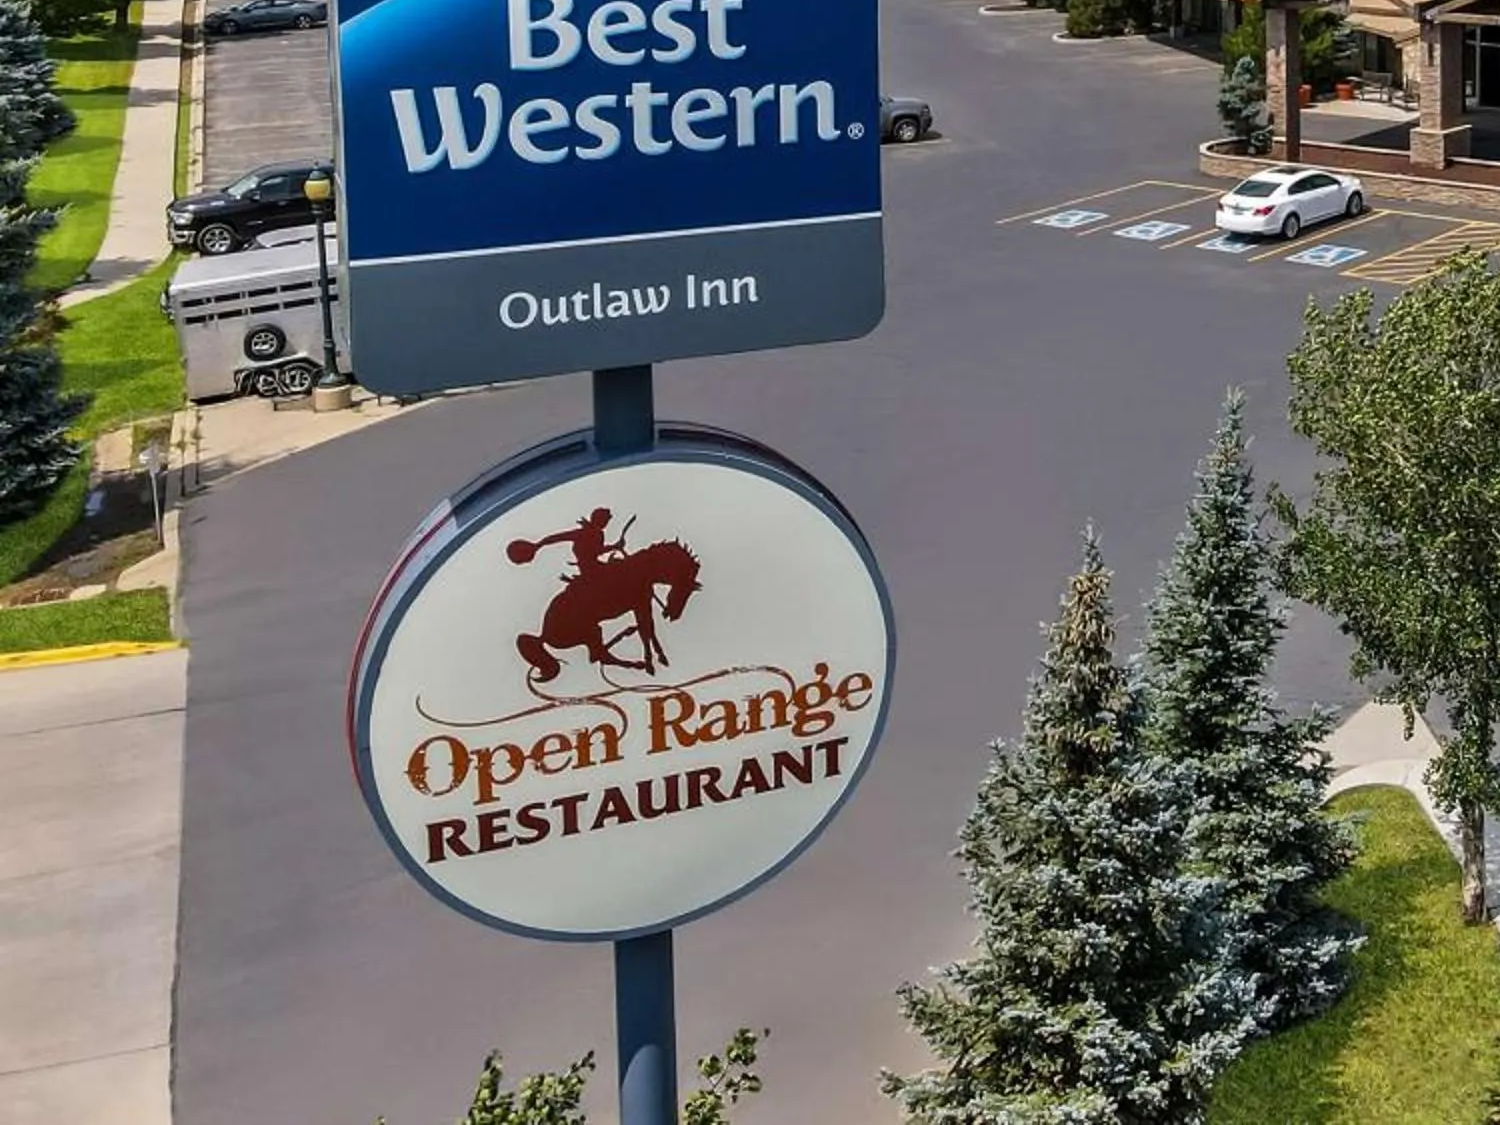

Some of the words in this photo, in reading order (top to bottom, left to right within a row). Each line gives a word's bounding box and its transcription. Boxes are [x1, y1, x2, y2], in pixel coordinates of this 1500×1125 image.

[499, 283, 671, 329] Outlaw
[685, 274, 758, 309] Inn
[405, 722, 624, 804] Open
[646, 662, 873, 755] Range
[425, 737, 849, 864] RESTAURANT
